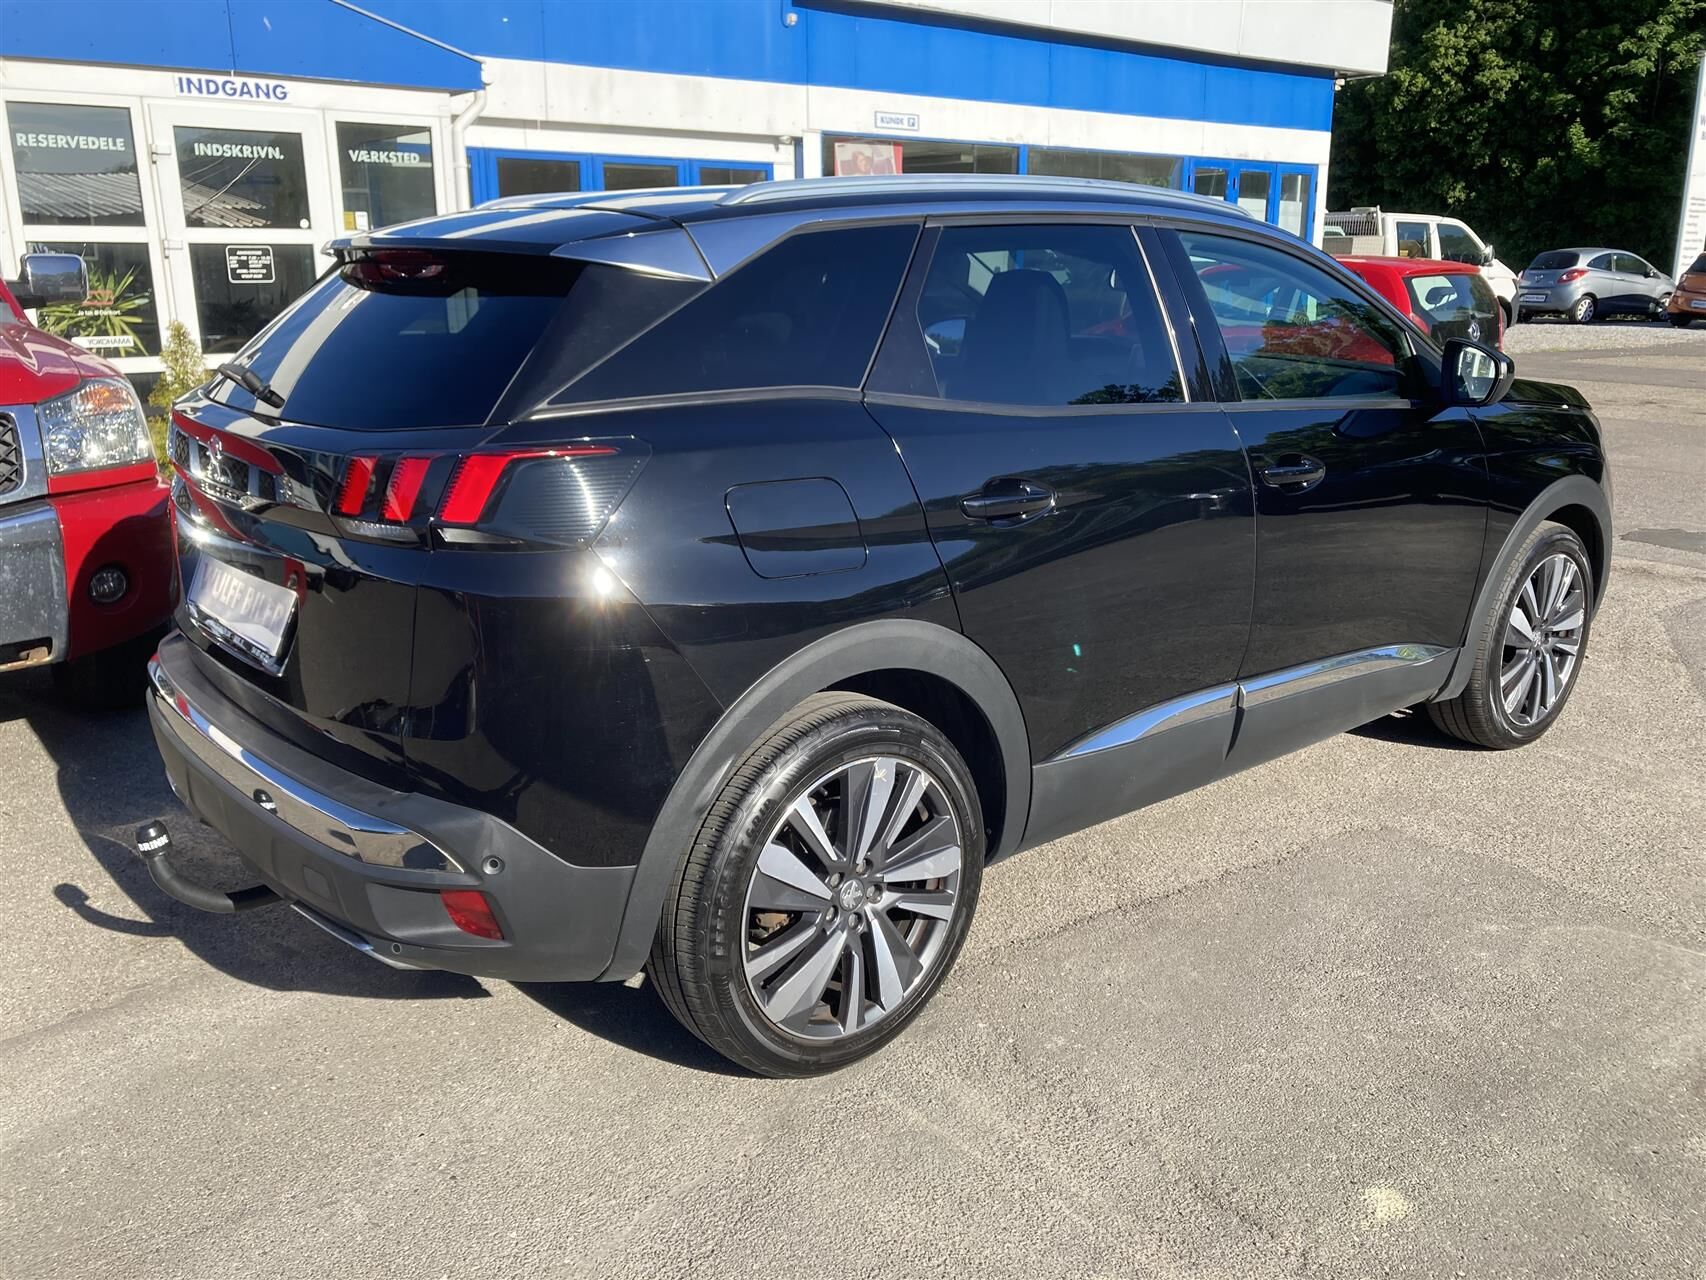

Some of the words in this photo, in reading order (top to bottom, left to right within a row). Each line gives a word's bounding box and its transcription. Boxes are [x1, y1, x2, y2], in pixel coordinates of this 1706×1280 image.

[177, 77, 288, 100] INDGANG
[15, 132, 126, 151] RESERVEDELE
[194, 142, 285, 160] INDSKRIVN.
[348, 149, 420, 164] VÆRKSTED
